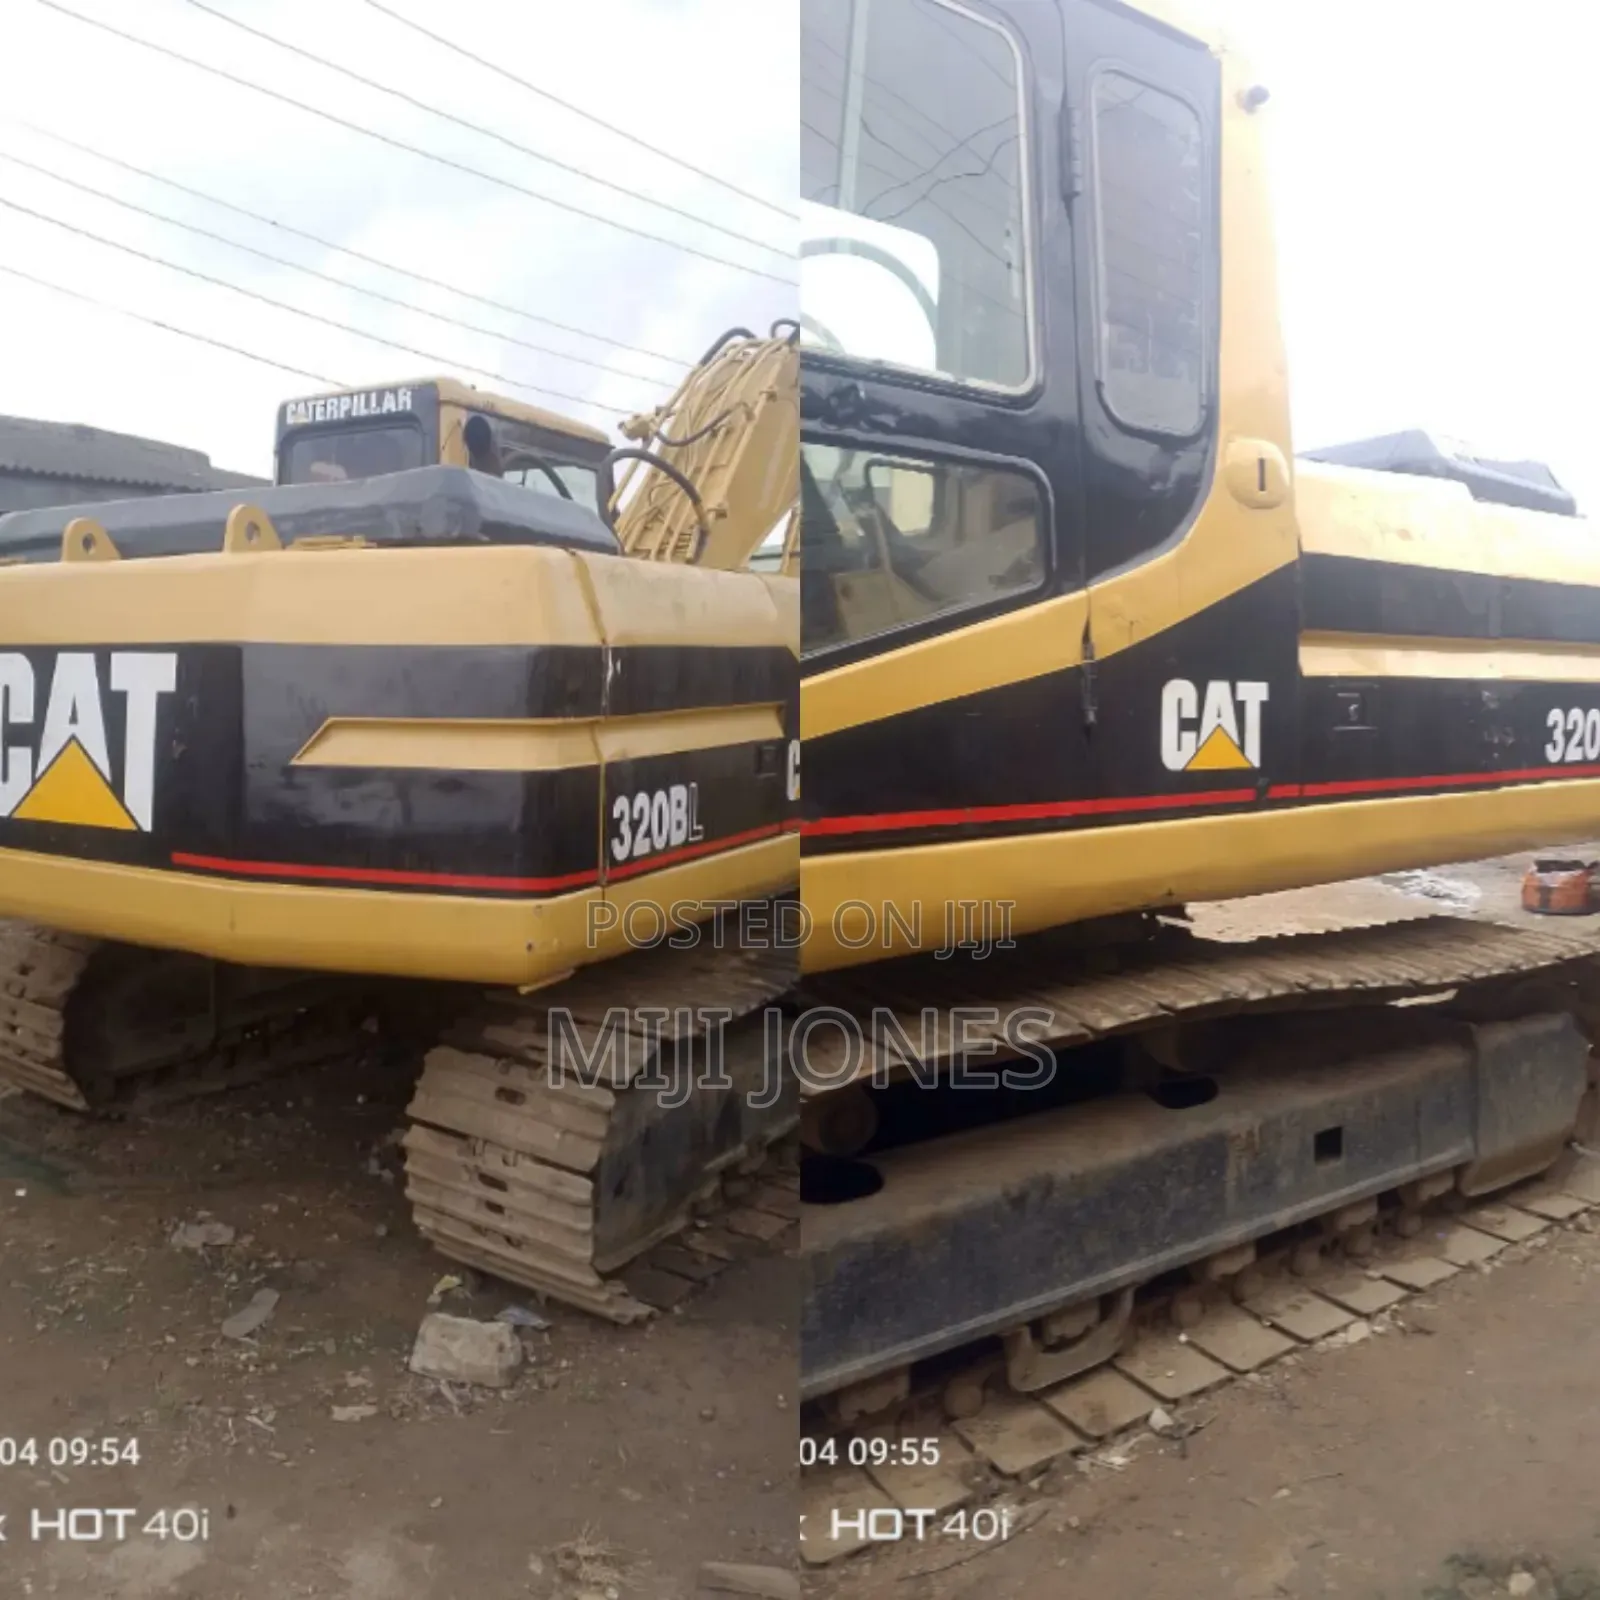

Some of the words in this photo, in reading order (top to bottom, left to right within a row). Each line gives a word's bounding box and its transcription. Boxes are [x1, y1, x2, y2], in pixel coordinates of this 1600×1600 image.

[286, 386, 412, 425] CATERPILLAR
[0, 652, 178, 832] CAT
[1161, 678, 1269, 771] CAT
[1544, 706, 1600, 763] 320
[611, 781, 704, 861] 320BL
